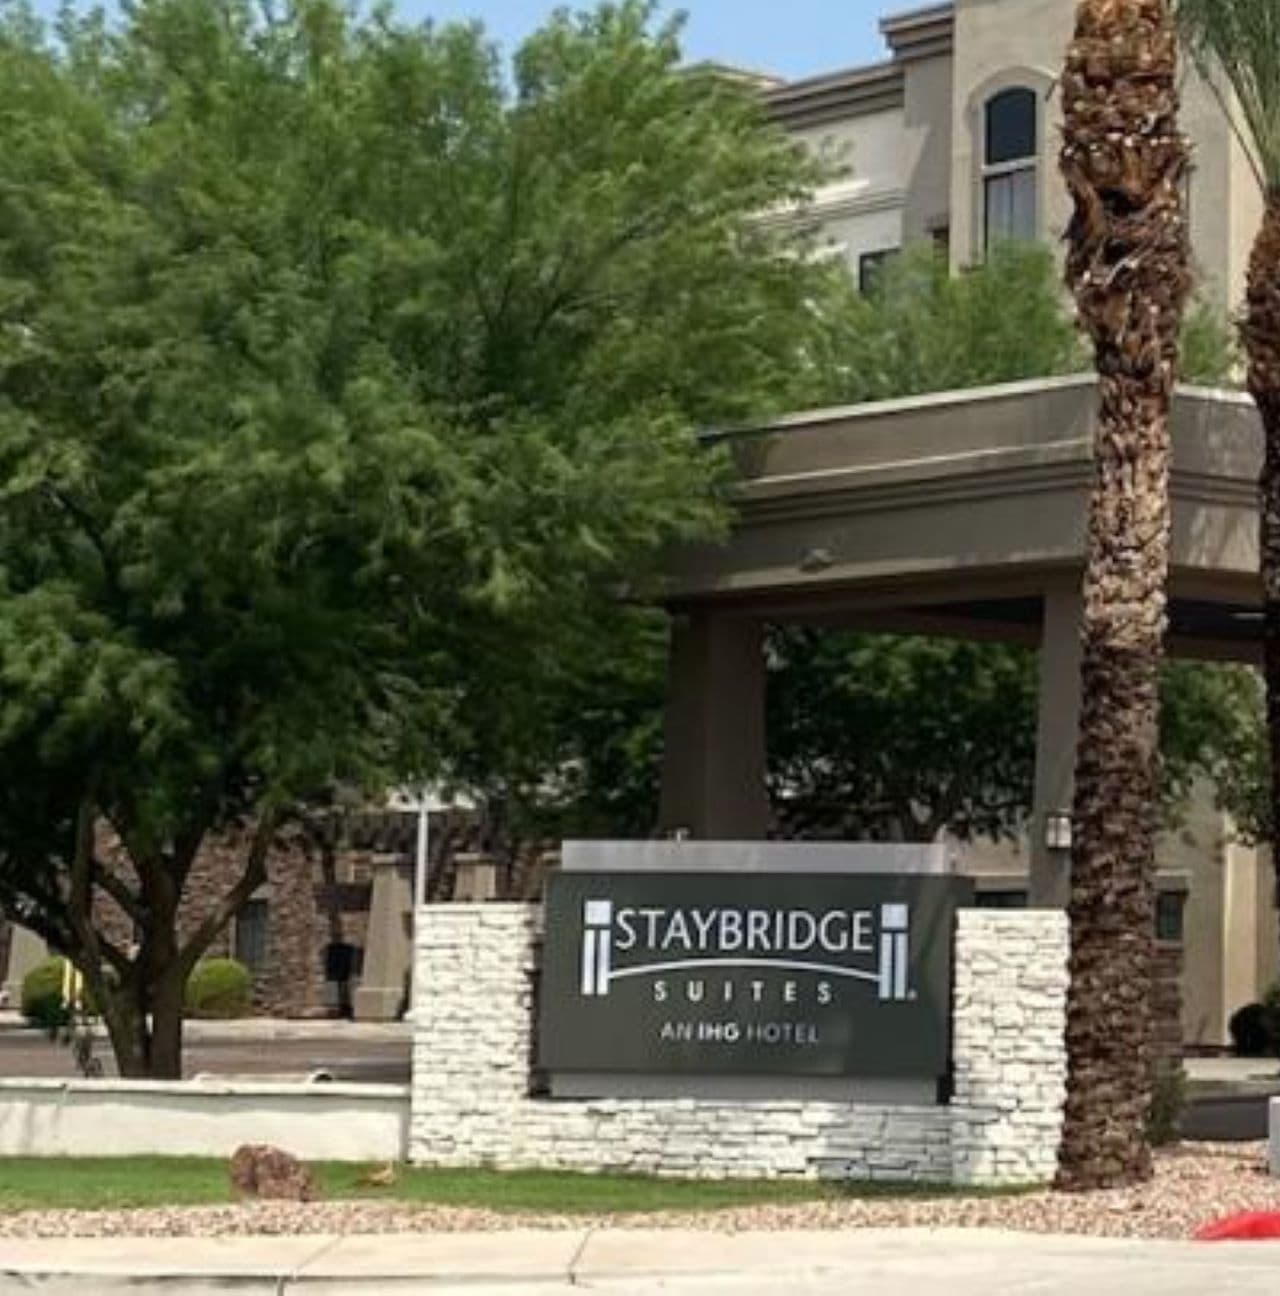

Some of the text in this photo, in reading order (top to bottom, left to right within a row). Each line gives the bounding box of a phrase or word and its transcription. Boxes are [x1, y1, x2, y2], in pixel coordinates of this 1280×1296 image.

[614, 908, 874, 952] STAYBRIDGE
[653, 981, 833, 1003] SUITES
[660, 1022, 819, 1043] AN IHG HOTEL
